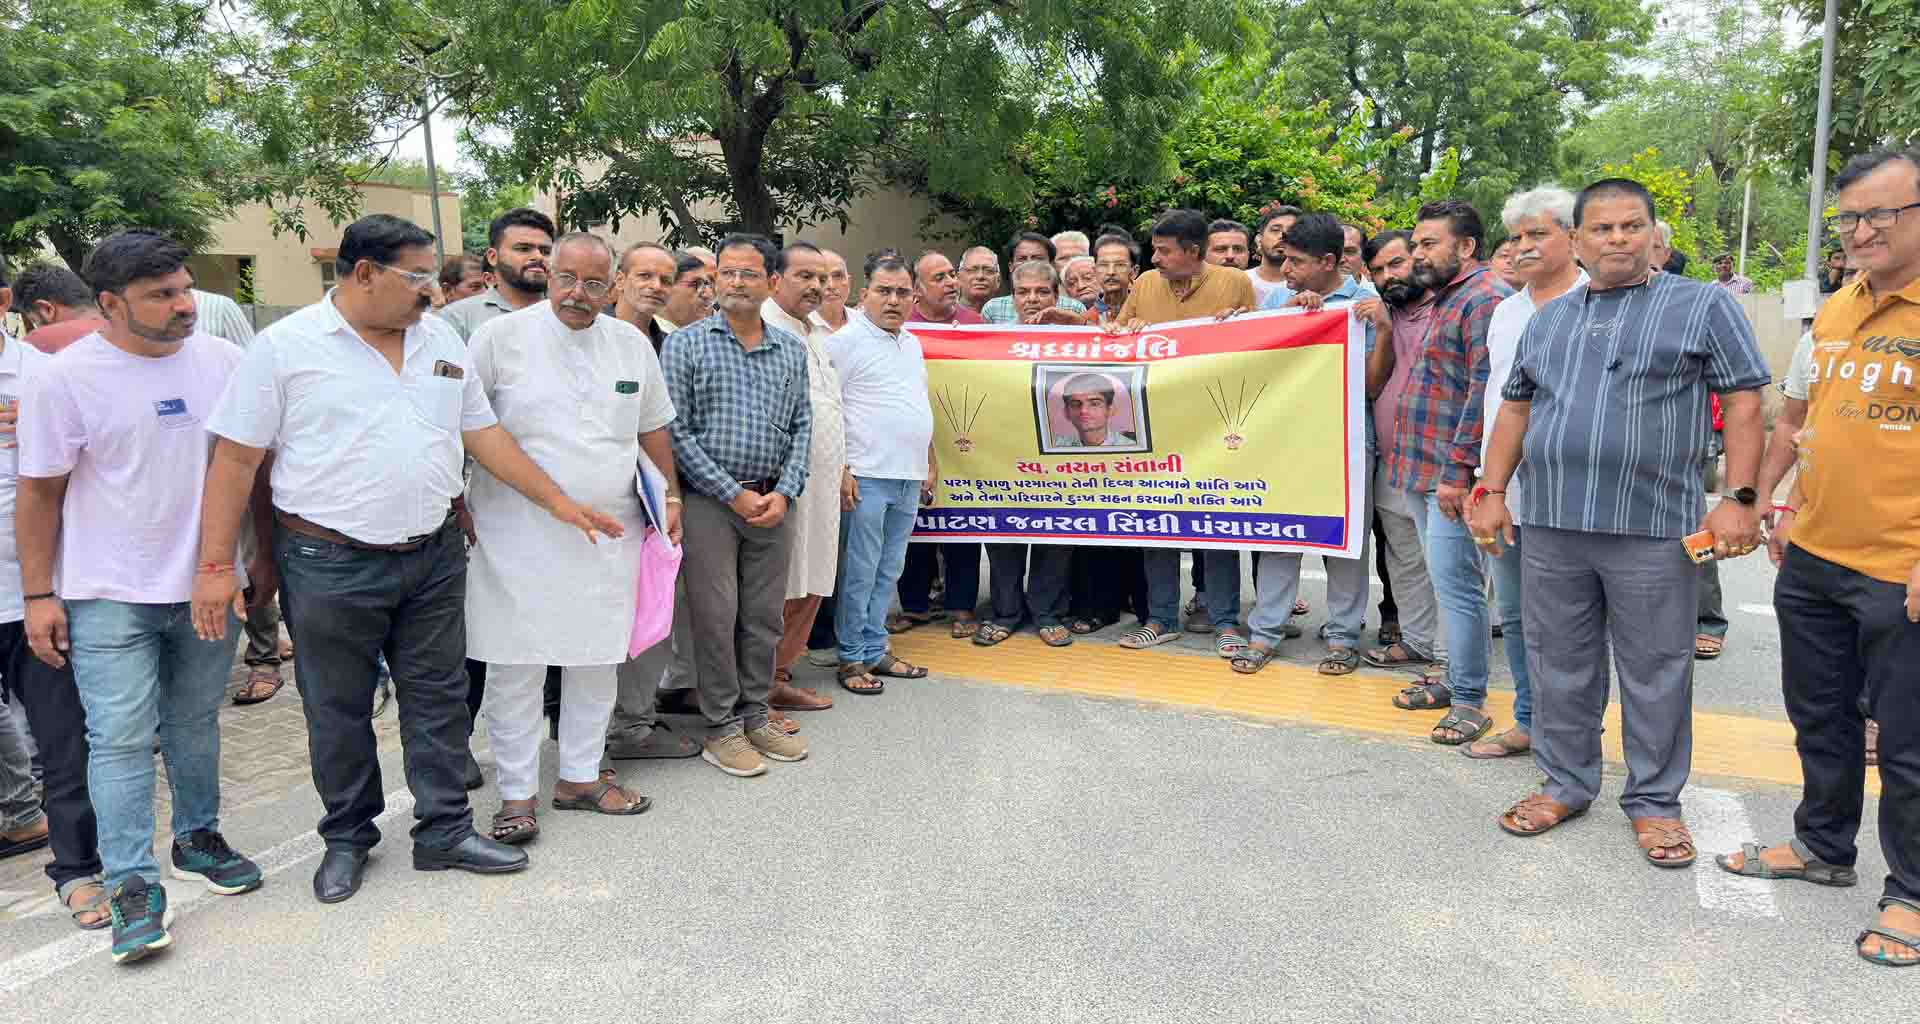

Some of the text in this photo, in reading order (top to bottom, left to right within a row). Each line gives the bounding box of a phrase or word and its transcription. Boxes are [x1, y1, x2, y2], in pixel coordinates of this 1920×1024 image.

[1016, 453, 1182, 475] સ્વ. નયન સંતાની
[944, 477, 1267, 491] પરમ કૃપાળુ પરમાત્મા તેની દિવ્ય આત્માને શાંતિ આપે
[949, 491, 974, 502] અને
[978, 491, 1003, 502] તેના
[1007, 491, 1063, 503] પરિવારને
[1099, 494, 1132, 504] સહન
[1136, 493, 1183, 505] કરવાની
[1188, 494, 1225, 506] શક્તિ
[1230, 495, 1263, 506] આપે
[916, 512, 1306, 539] પાટણ જનરલ સિંધી પંચાયત
